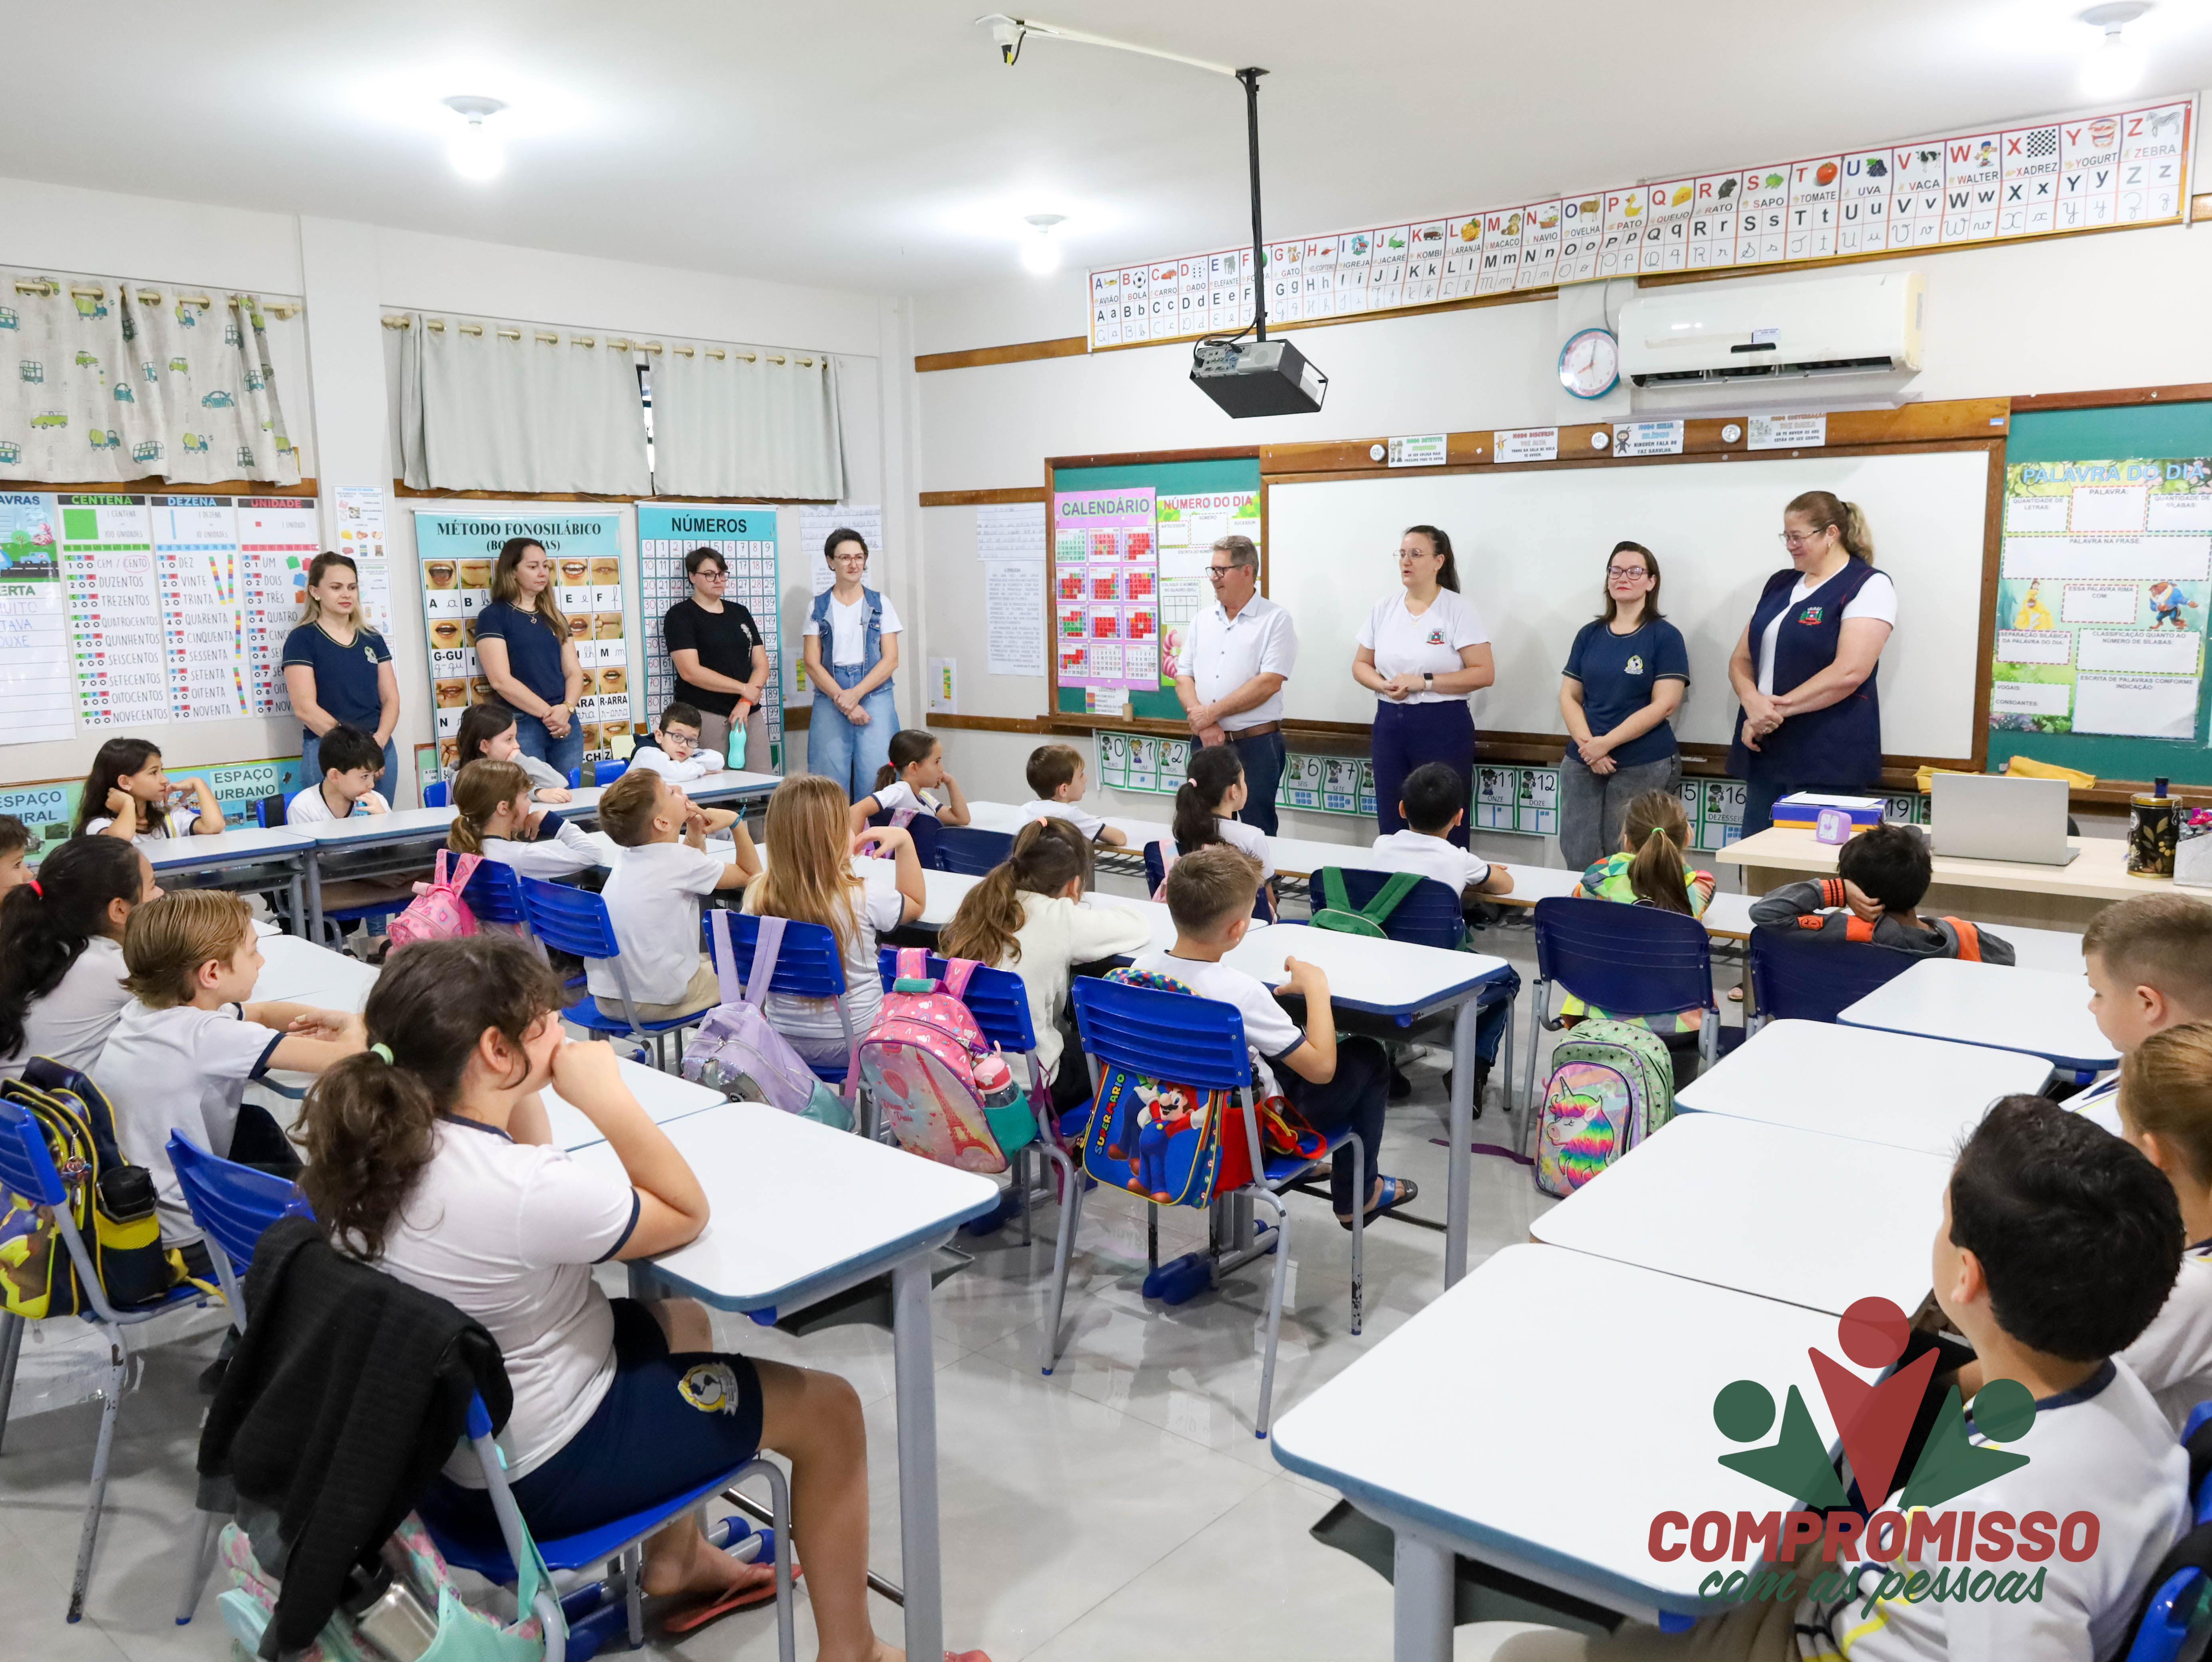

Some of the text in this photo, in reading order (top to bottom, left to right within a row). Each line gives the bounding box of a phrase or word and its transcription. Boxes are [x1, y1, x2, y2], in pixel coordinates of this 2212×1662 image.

[2135, 146, 2176, 158] ZEBRA
[2075, 153, 2117, 168] YOGURT
[2016, 163, 2057, 177] XADREZ
[1957, 171, 1998, 184] WALTER
[1858, 186, 1880, 195] UVA
[1909, 180, 1940, 191] VACA
[1800, 192, 1836, 203] TOMATE
[1705, 204, 1733, 214] RATO
[1753, 198, 1784, 209] SAPO
[1657, 212, 1689, 223] QUEIJO
[1617, 220, 1642, 230] PATO
[1571, 226, 1600, 237] OVELHA
[1533, 232, 1557, 243] NAVIO
[1451, 245, 1480, 254] LARANJA
[1490, 239, 1519, 249] MACACO
[1378, 254, 1406, 264] JACARÉ
[1417, 249, 1442, 259] KOMBI
[1282, 268, 1300, 276] GATO
[1308, 263, 1335, 272] HELICÓPTERO
[1186, 283, 1205, 291] DADO
[1213, 278, 1239, 287] ELEFANTE
[1128, 291, 1147, 300] BOLA
[1154, 288, 1177, 296] CARRO
[1099, 294, 1119, 305] AVIÃO
[2023, 464, 2205, 483] PALAVRA DO DIA
[72, 495, 133, 504] CENTENA
[168, 497, 217, 506] DEZENA
[251, 499, 301, 508] UNIDADE
[1164, 495, 1253, 510] NÚMERO DO DIA
[1062, 497, 1150, 516] CALENDÁRIO
[437, 519, 601, 536] MÉTODO FONOSILÁBICO
[672, 514, 747, 533] NÚMEROS
[645, 541, 652, 551] 0
[660, 542, 664, 551] 1
[673, 542, 678, 551] 2
[740, 543, 744, 552] 7
[765, 543, 770, 552] 9
[97, 559, 112, 569] CEM
[123, 559, 147, 569] CENTO
[179, 558, 195, 569] DEZ
[263, 559, 276, 568] UM
[645, 561, 654, 570] 10
[659, 561, 666, 569] 11
[739, 561, 747, 570] 17
[764, 561, 773, 570] 19
[99, 576, 143, 588] DUZENTOS
[181, 577, 207, 587] VINTE
[265, 575, 282, 586] DOIS
[643, 580, 655, 590] 20
[658, 580, 668, 589] 21
[764, 580, 774, 588] 29
[102, 595, 150, 606] TREZENTOS
[183, 594, 214, 606] TRINTA
[266, 591, 284, 604] TRÊS
[566, 594, 572, 603] E
[430, 599, 438, 608] A
[102, 615, 158, 628] QUATROCENTOS
[185, 612, 228, 625] QUARENTA
[267, 611, 298, 623] QUATRO
[105, 634, 160, 647] QUINHENTOS
[187, 630, 234, 644] CINQUENTA
[109, 653, 159, 665] SEISCENTOS
[189, 649, 228, 662] SESSENTA
[434, 651, 462, 660] G-GU
[109, 674, 161, 686] SETECENTOS
[191, 669, 226, 680] SETENTA
[112, 692, 163, 704] OITOCENTOS
[192, 686, 226, 699] OITENTA
[600, 696, 627, 706] R-ARRA
[193, 704, 231, 717] NOVENTA
[113, 710, 168, 723] NOVECENTOS
[770, 724, 780, 734] 1000
[1114, 738, 1124, 757] 0
[1147, 742, 1152, 760] 1
[1172, 744, 1183, 763] 2
[1308, 758, 1318, 776] 6
[1342, 762, 1355, 780] 7
[214, 769, 273, 784] ESPAÇO
[1498, 772, 1514, 788] 11
[1538, 774, 1555, 791] 12
[215, 785, 275, 800] URBANO
[1726, 786, 1746, 805] 16
[1094, 1073, 1126, 1155] SUPER MARIO
